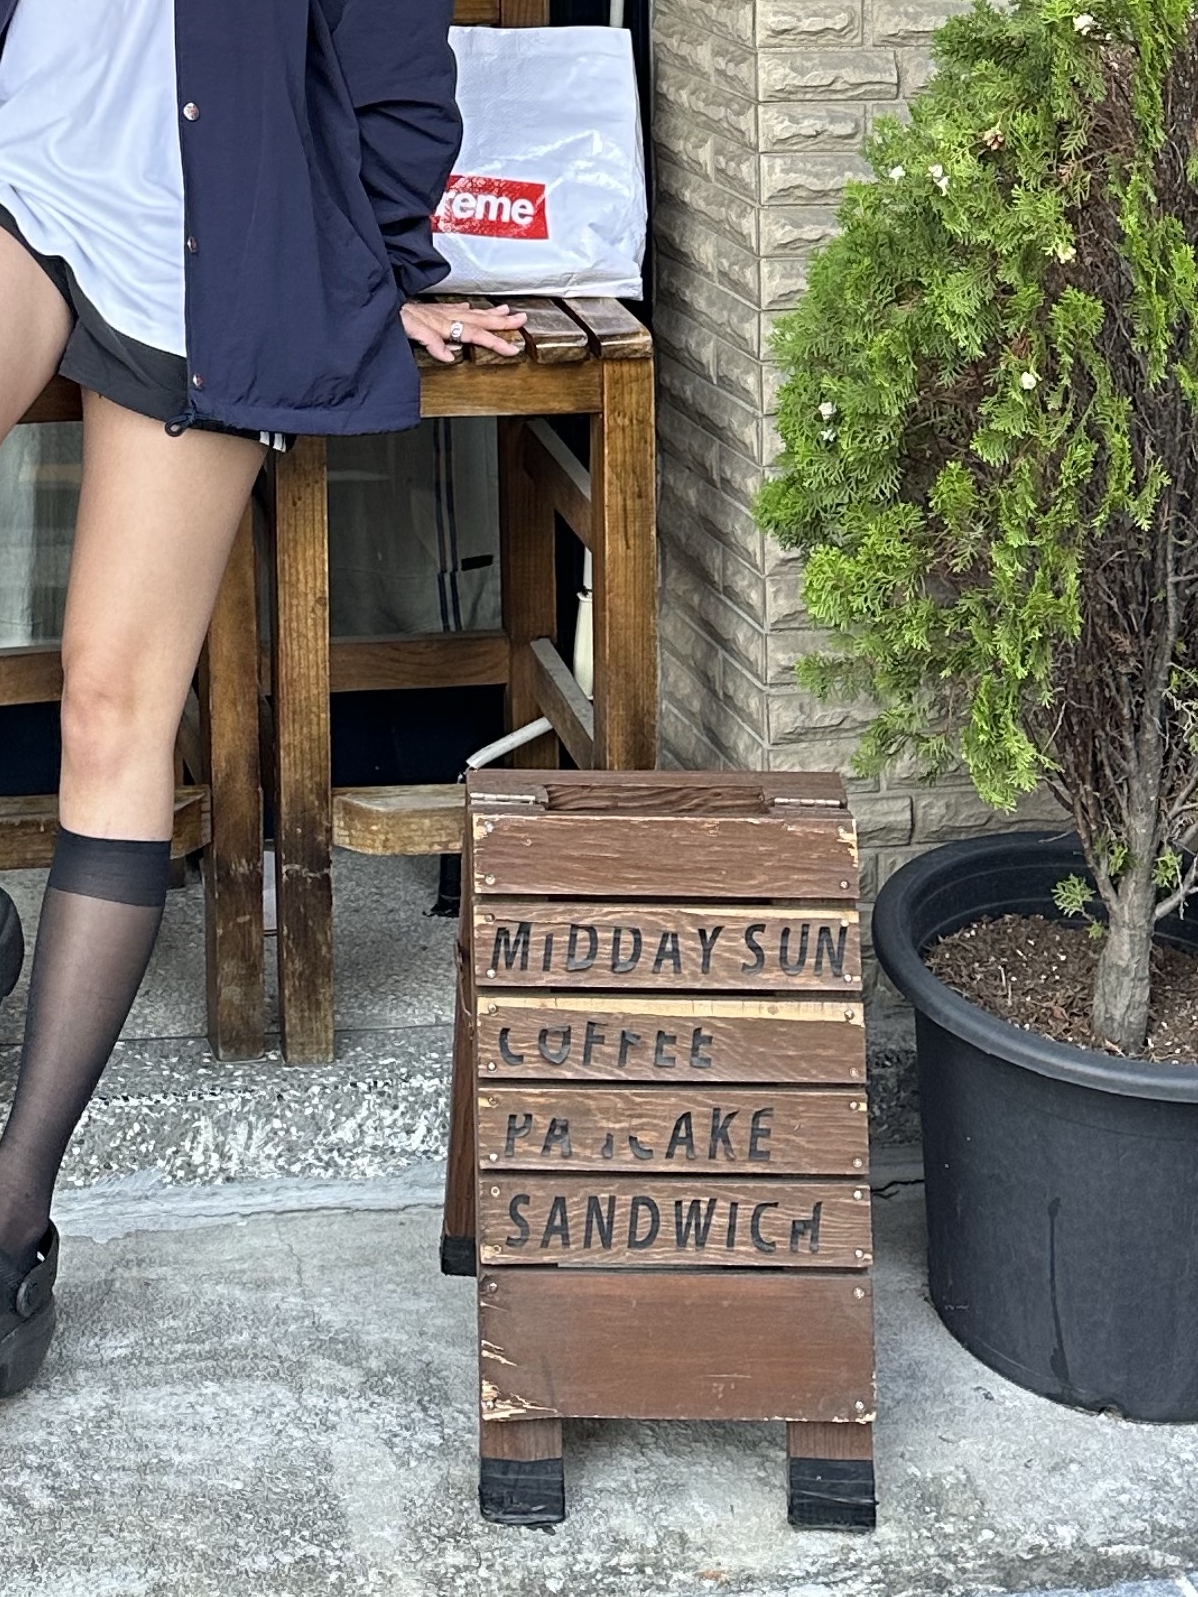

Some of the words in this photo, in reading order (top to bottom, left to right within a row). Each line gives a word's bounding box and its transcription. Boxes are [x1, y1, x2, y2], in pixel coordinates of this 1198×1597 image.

[491, 922, 724, 974] MIDDAY
[742, 923, 848, 977] SUN
[505, 1107, 774, 1161] PAAKE
[506, 1193, 823, 1254] SANDWICH
